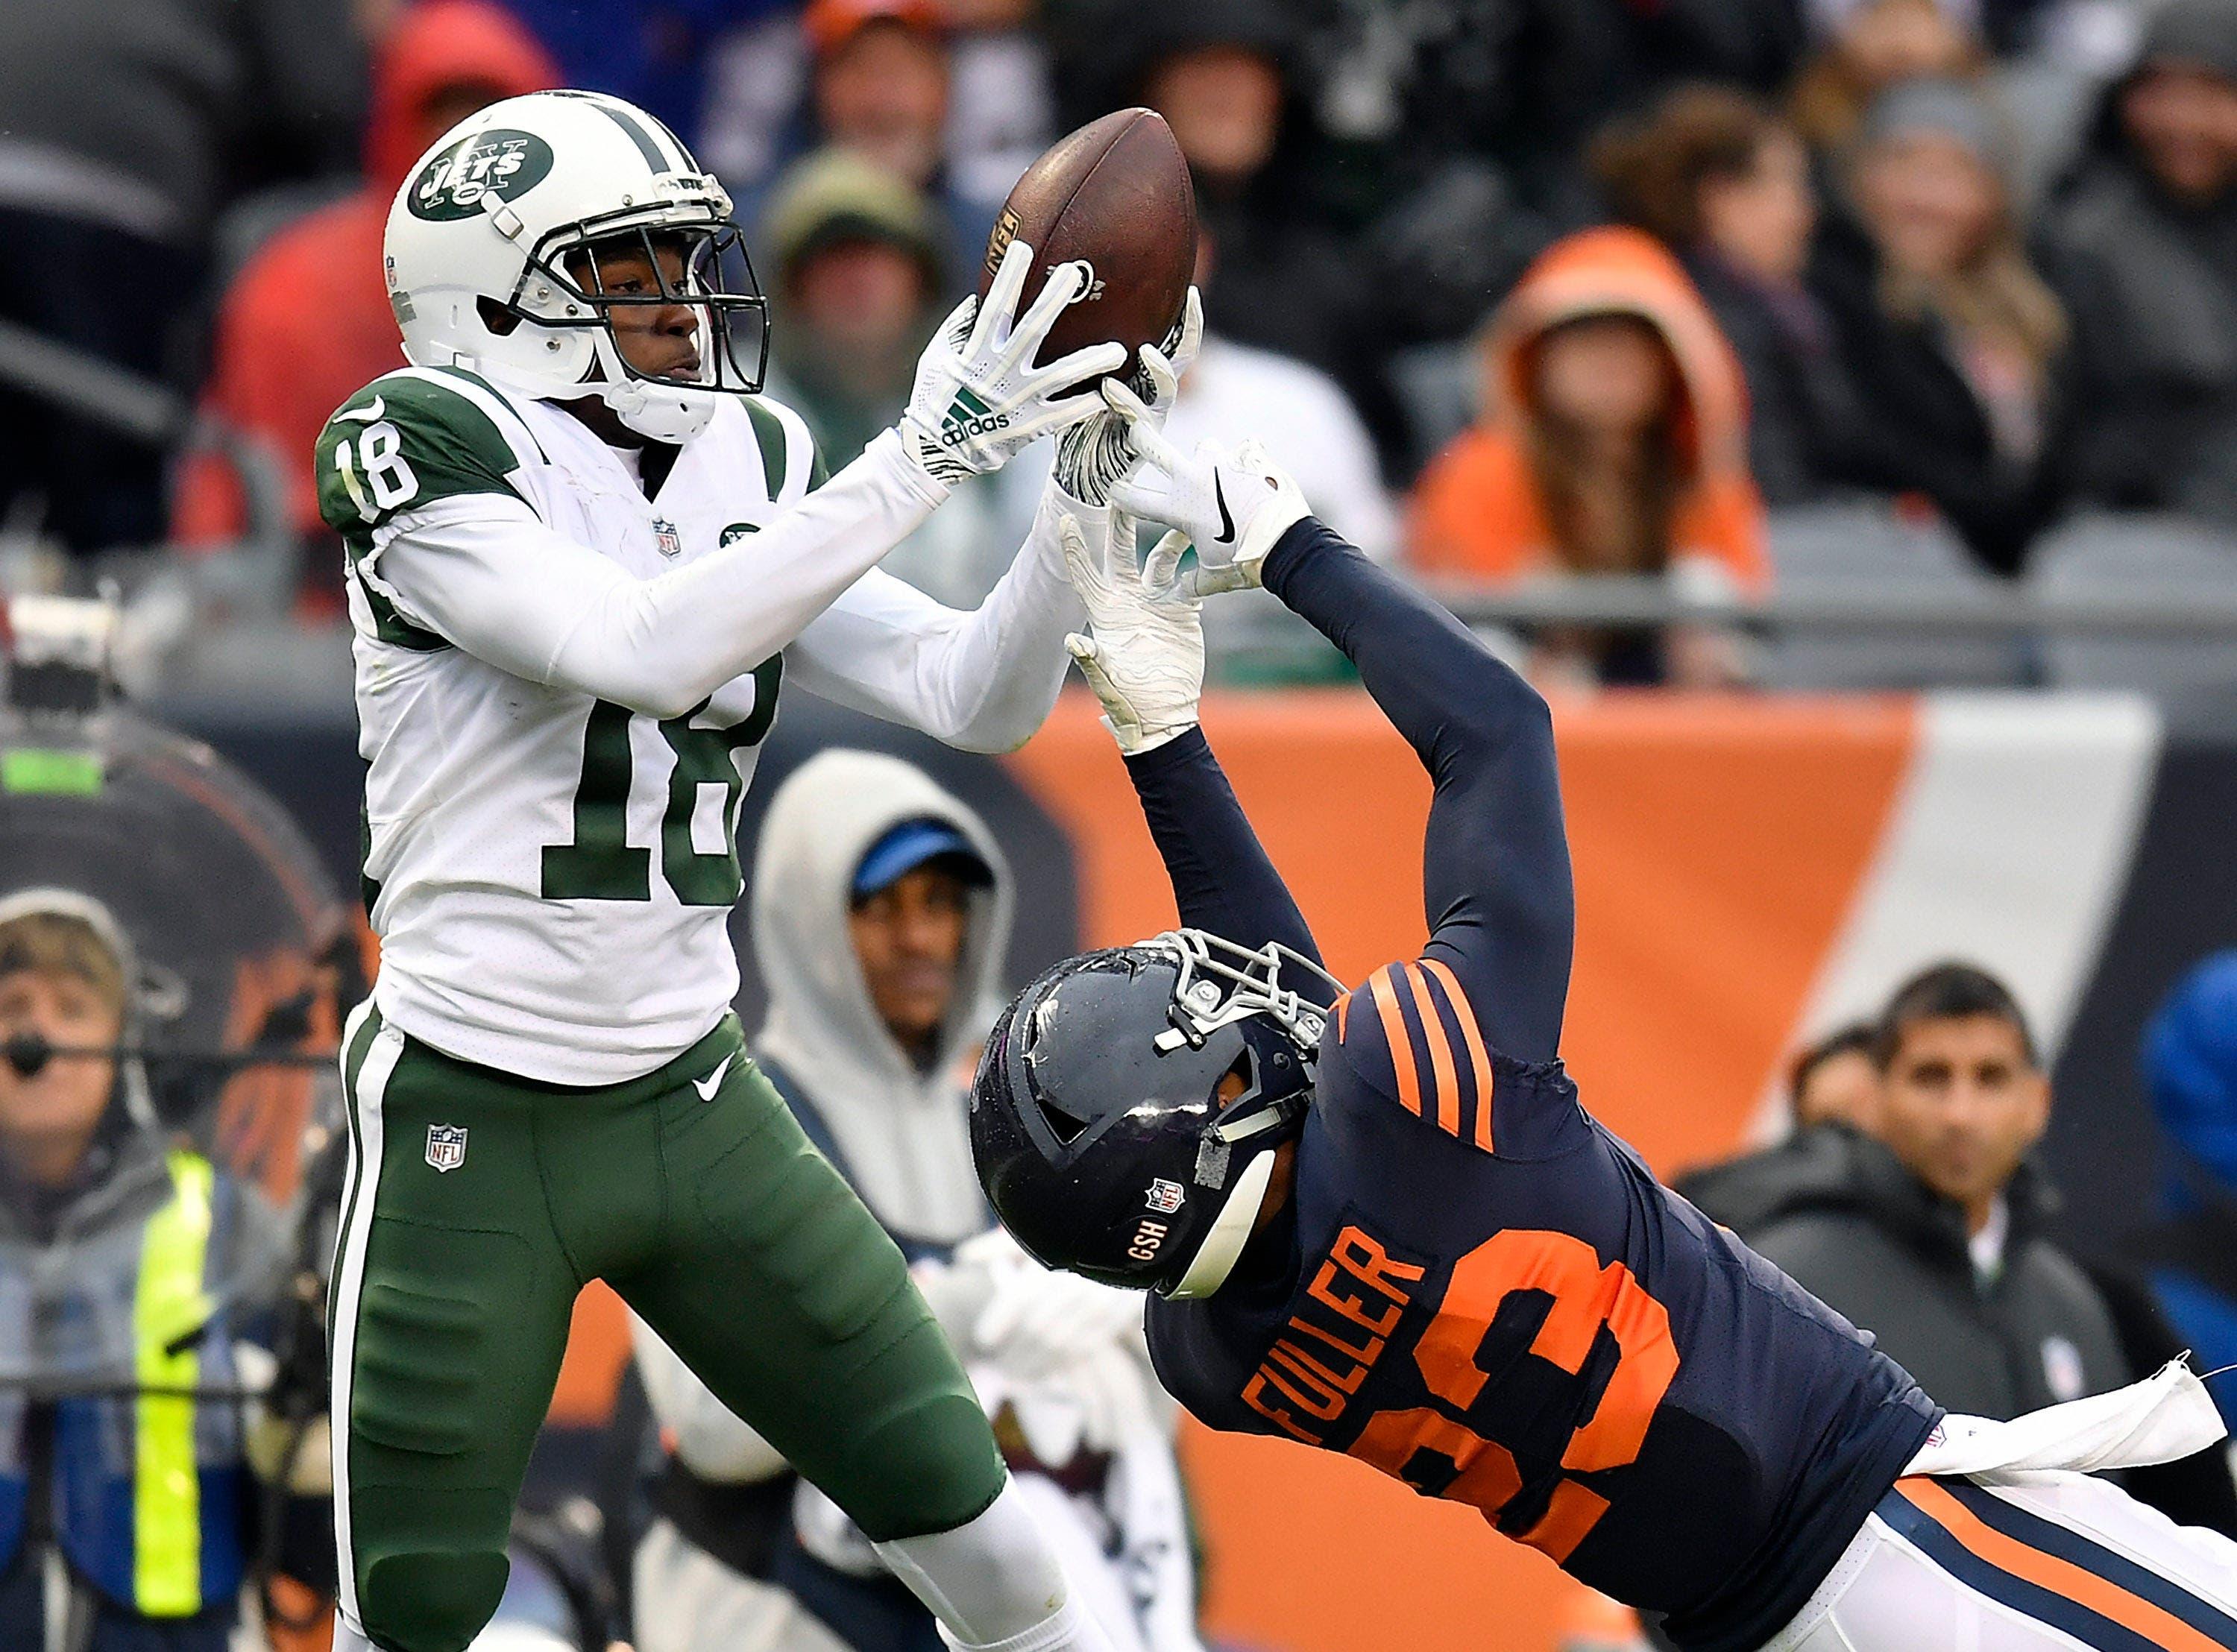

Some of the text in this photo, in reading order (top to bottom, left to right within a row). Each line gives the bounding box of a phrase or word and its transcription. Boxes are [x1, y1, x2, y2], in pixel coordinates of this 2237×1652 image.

[420, 152, 525, 200] JETS
[942, 414, 1010, 447] adidas
[336, 420, 419, 524] 18
[541, 651, 782, 907] 18
[432, 1143, 458, 1162] NFL
[1161, 1186, 1179, 1209] NFL
[1127, 1220, 1168, 1261] GSH
[1241, 1226, 1425, 1445] FULLER
